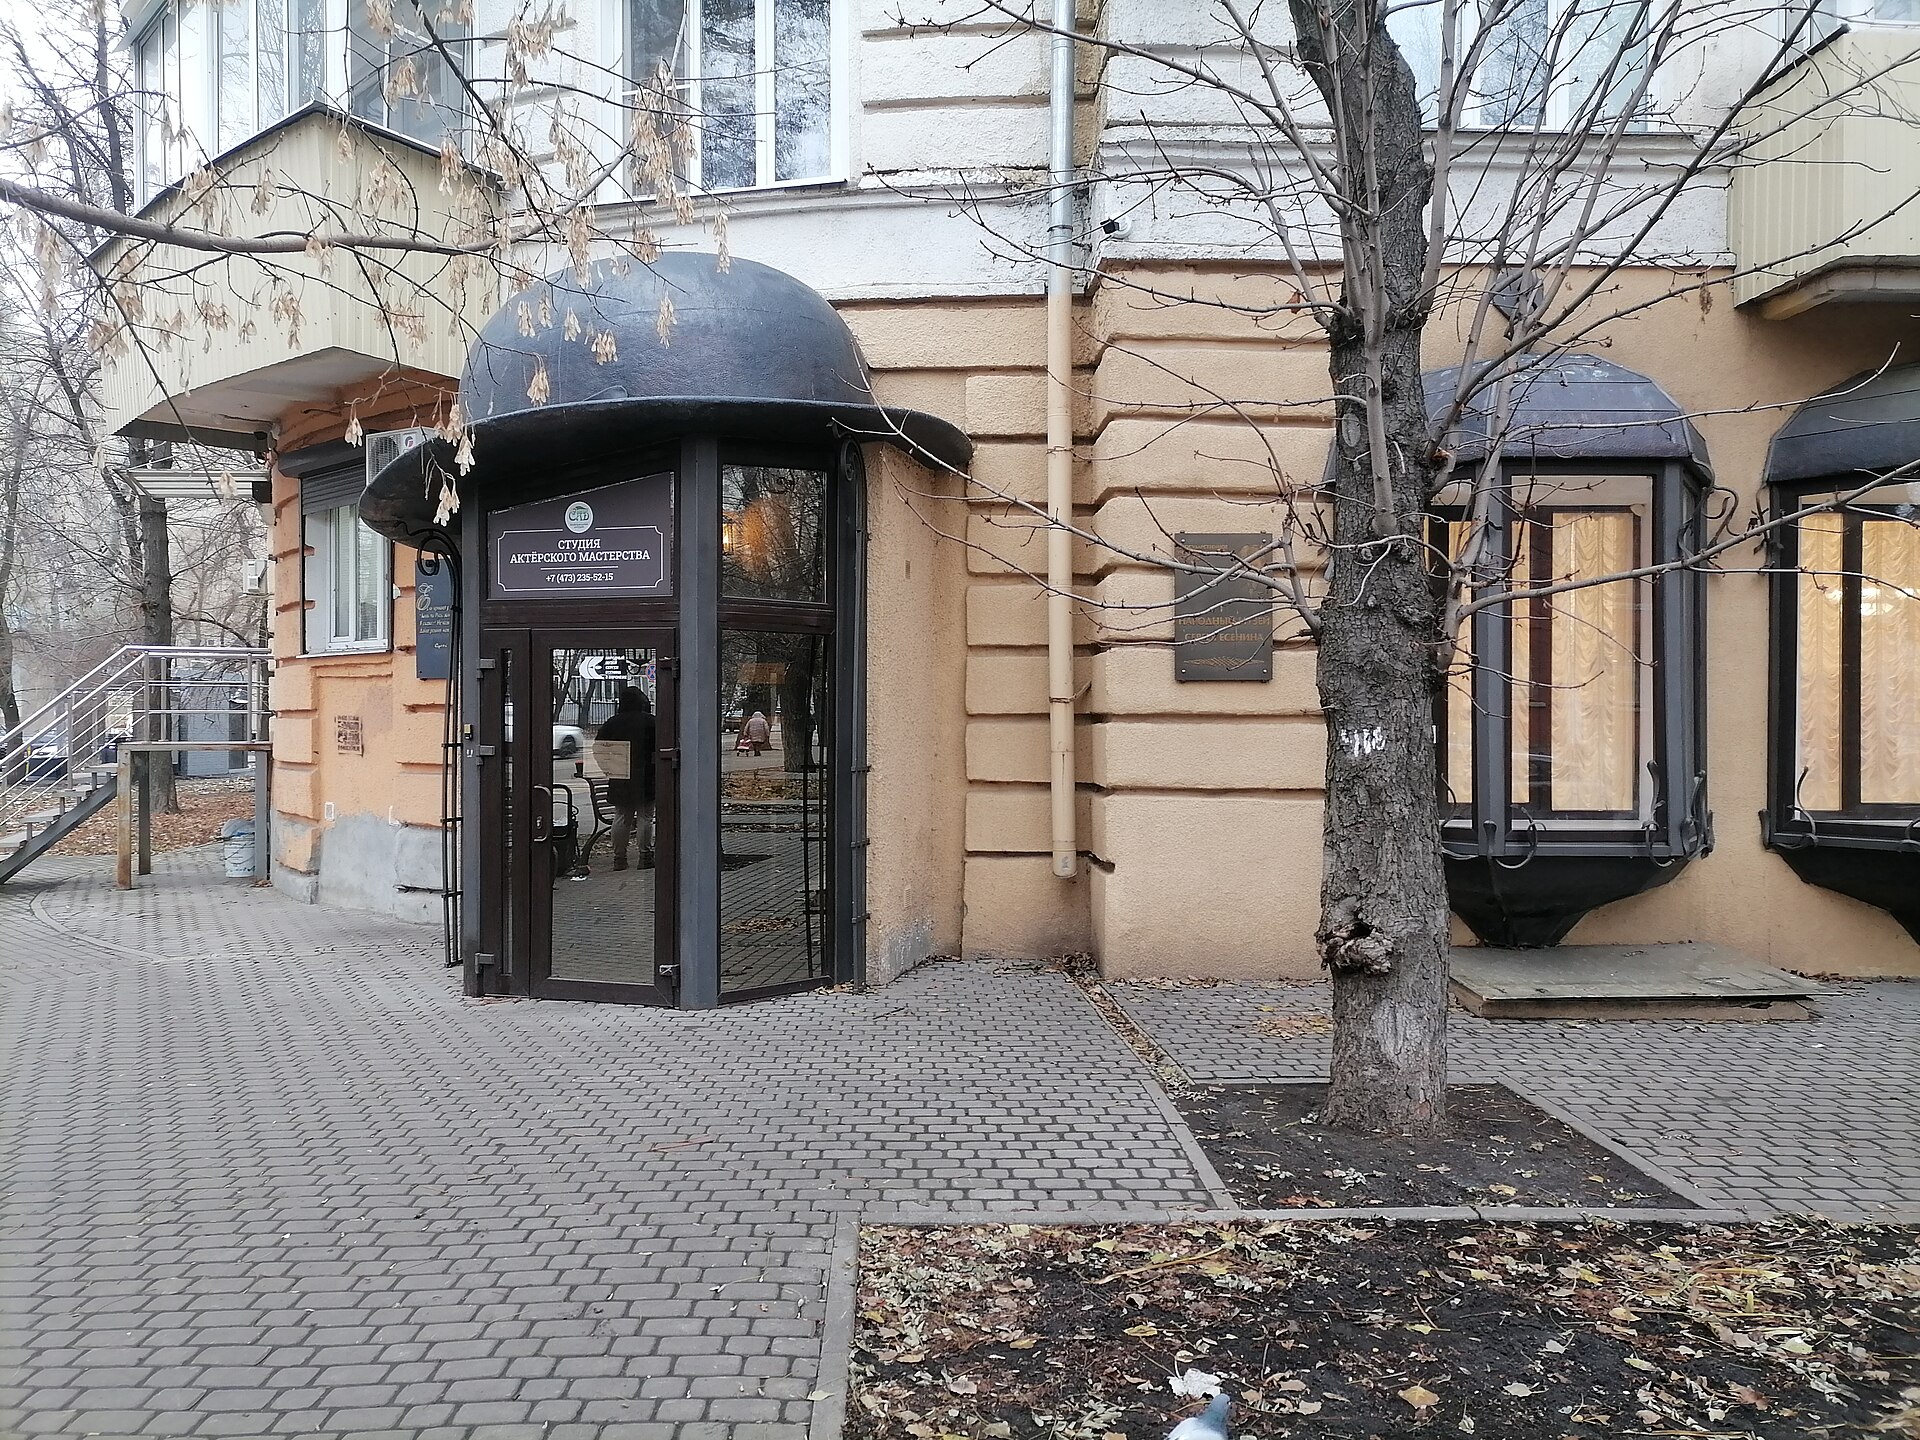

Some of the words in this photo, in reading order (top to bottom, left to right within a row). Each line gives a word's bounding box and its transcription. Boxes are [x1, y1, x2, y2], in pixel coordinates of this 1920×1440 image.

[558, 539, 601, 551] СТУДИЯ
[510, 551, 577, 563] АКТЁРСКОГО
[578, 549, 651, 562] МАСТЕРСТВА
[545, 573, 556, 582] +7
[556, 573, 576, 584] (473)
[577, 573, 614, 582] 235-52-15
[1220, 632, 1264, 642] ЕСЕНИНА
